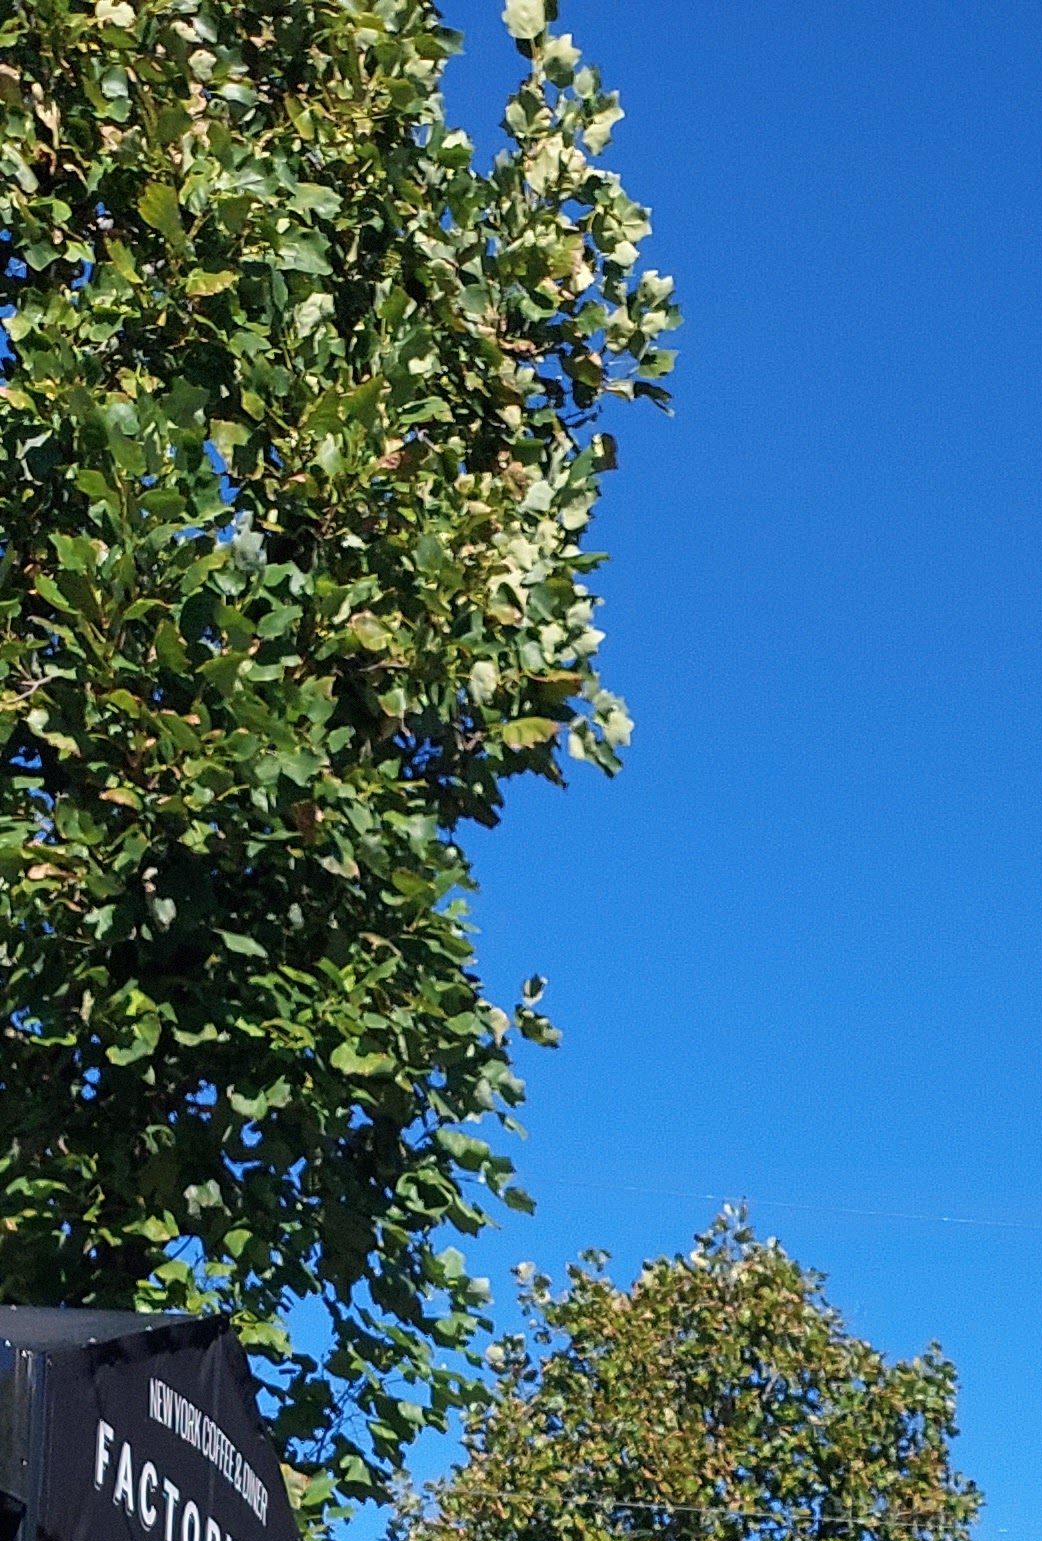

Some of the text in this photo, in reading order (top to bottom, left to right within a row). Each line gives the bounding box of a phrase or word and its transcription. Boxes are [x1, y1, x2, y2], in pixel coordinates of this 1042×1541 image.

[149, 1377, 268, 1527] NEW YORK COFFEE & DINER
